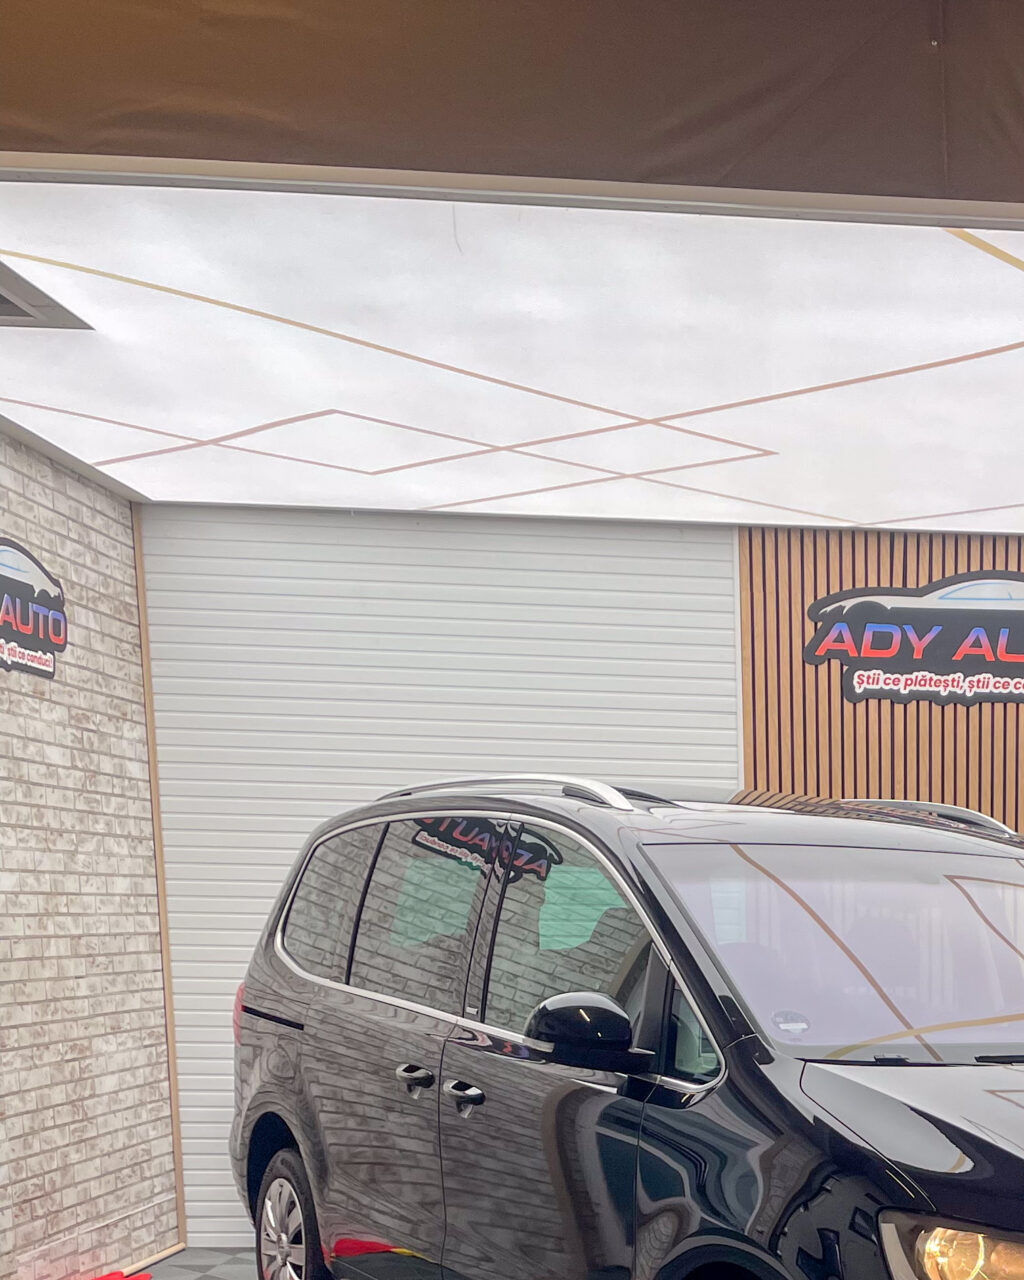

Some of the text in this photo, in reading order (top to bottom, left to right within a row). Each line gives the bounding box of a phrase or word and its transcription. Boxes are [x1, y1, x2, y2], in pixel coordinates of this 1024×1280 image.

[0, 593, 66, 645] AUTO
[815, 622, 942, 660] ADY
[856, 673, 880, 689] Știi
[883, 676, 901, 687] ce
[904, 674, 963, 693] plătești,
[967, 677, 990, 694] știi
[993, 680, 1011, 690] ce
